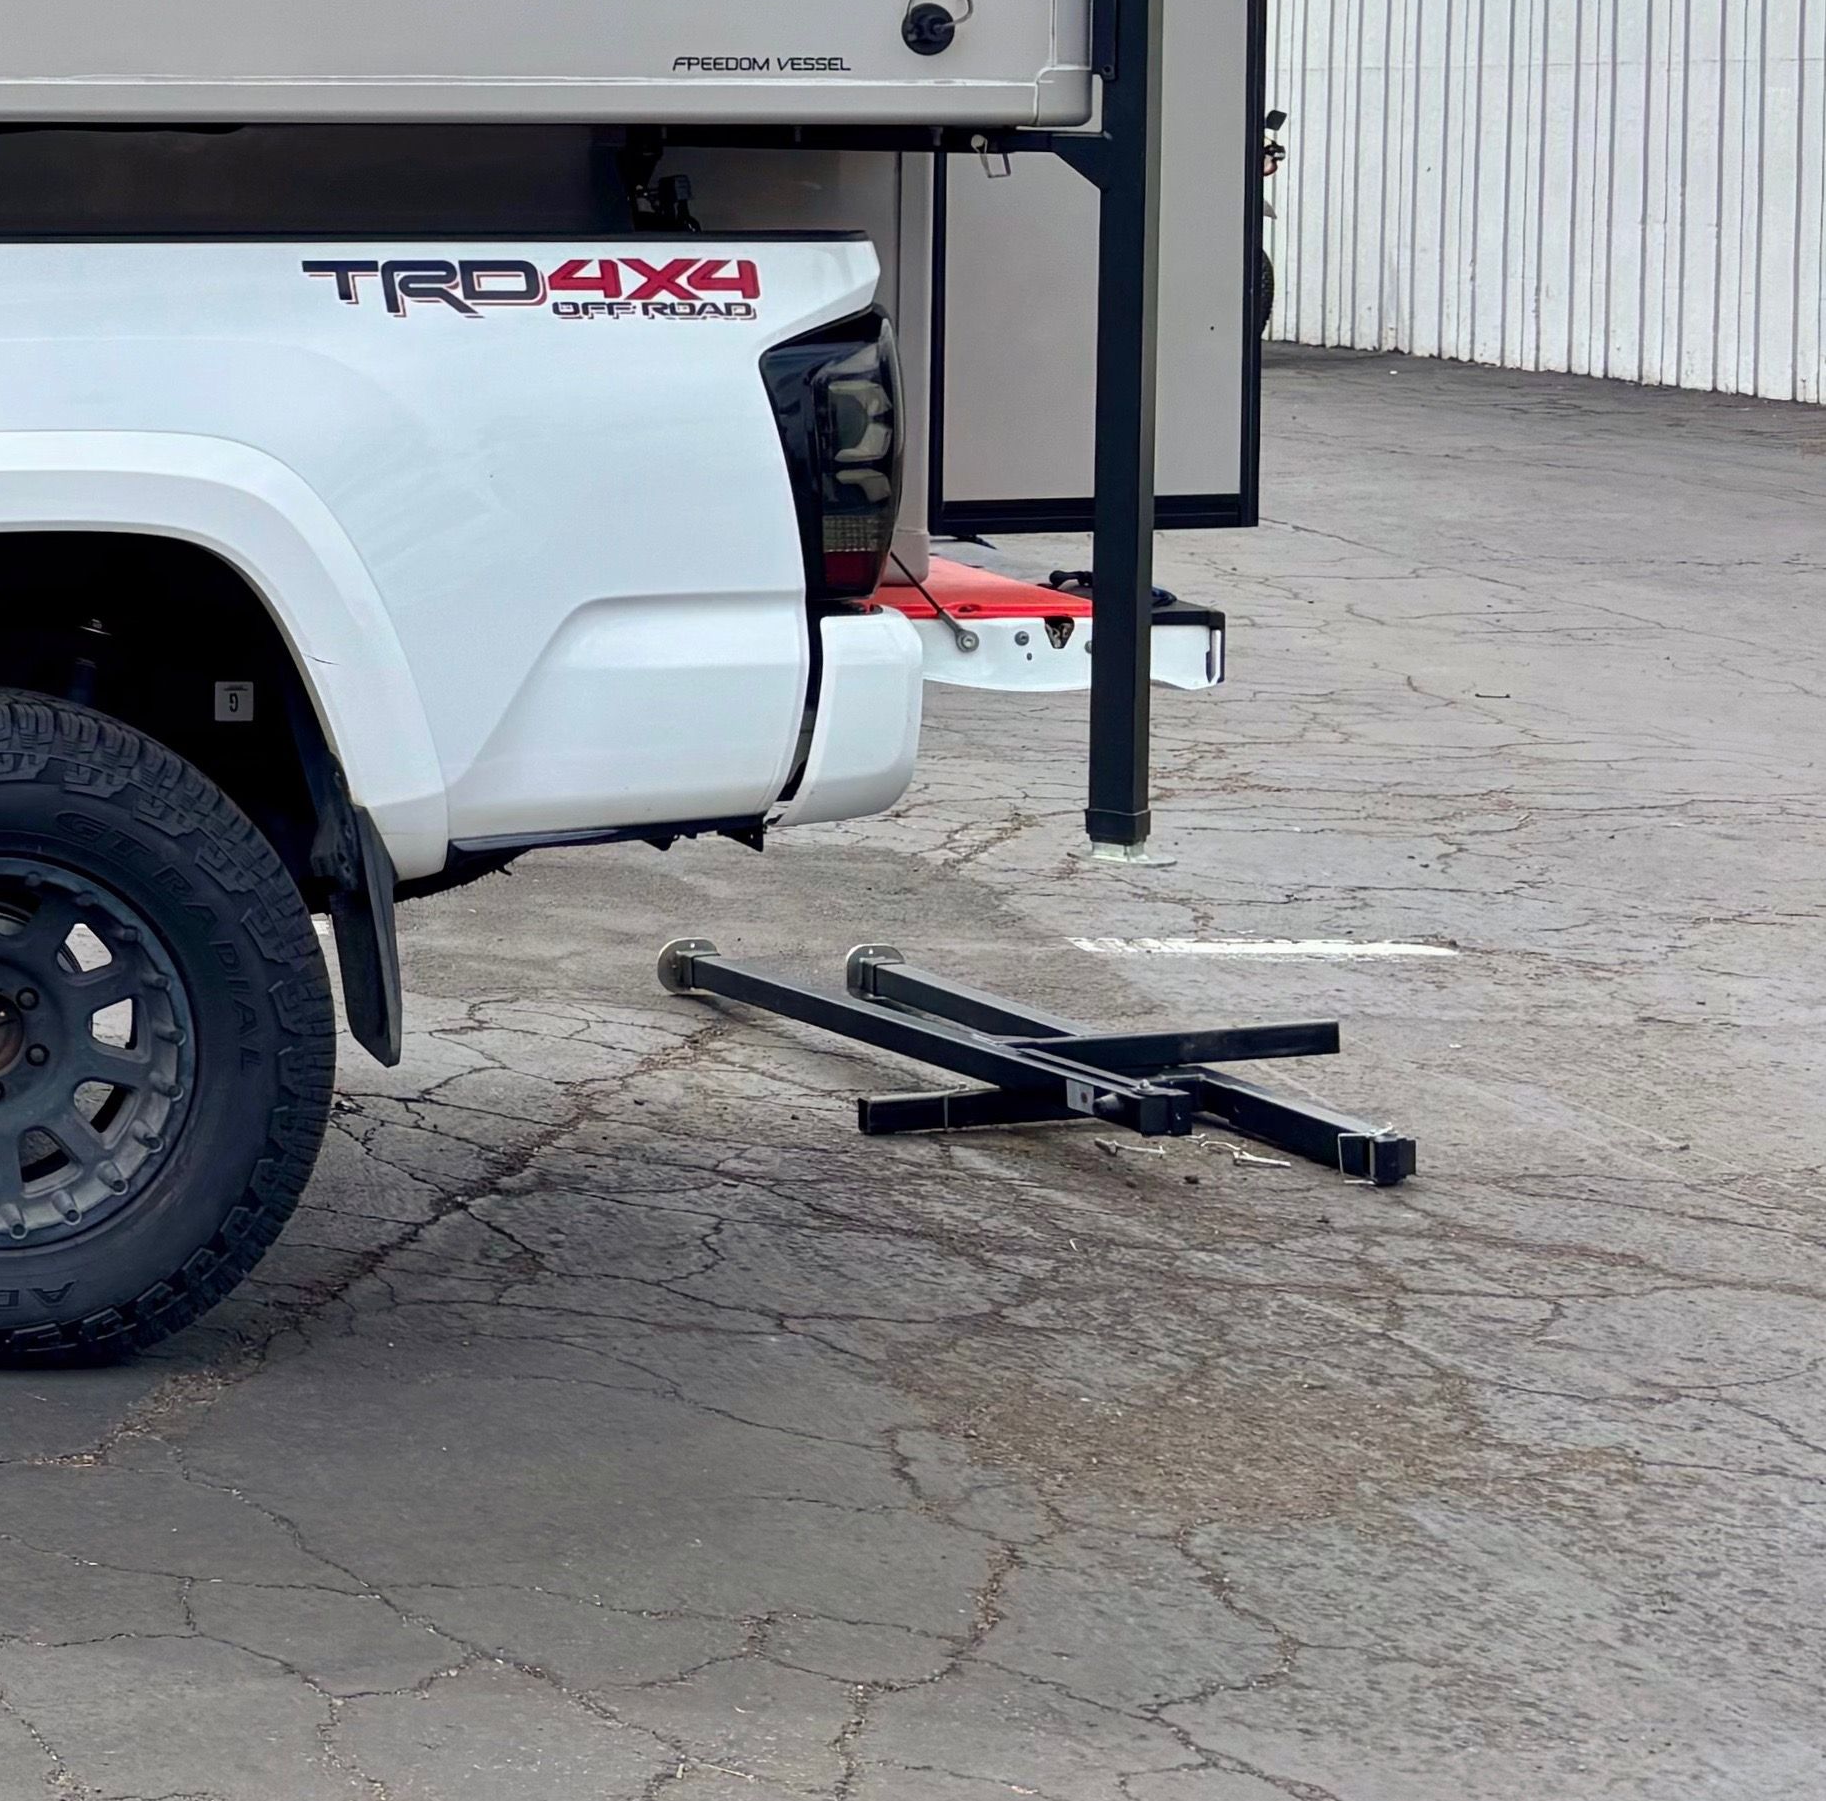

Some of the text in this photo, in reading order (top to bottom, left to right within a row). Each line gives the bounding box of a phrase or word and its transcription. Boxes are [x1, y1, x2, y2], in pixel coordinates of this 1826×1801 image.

[776, 56, 852, 71] VESSEL
[302, 260, 547, 318] TRD
[642, 302, 757, 320] ROAD
[150, 866, 263, 1071] RADIAL
